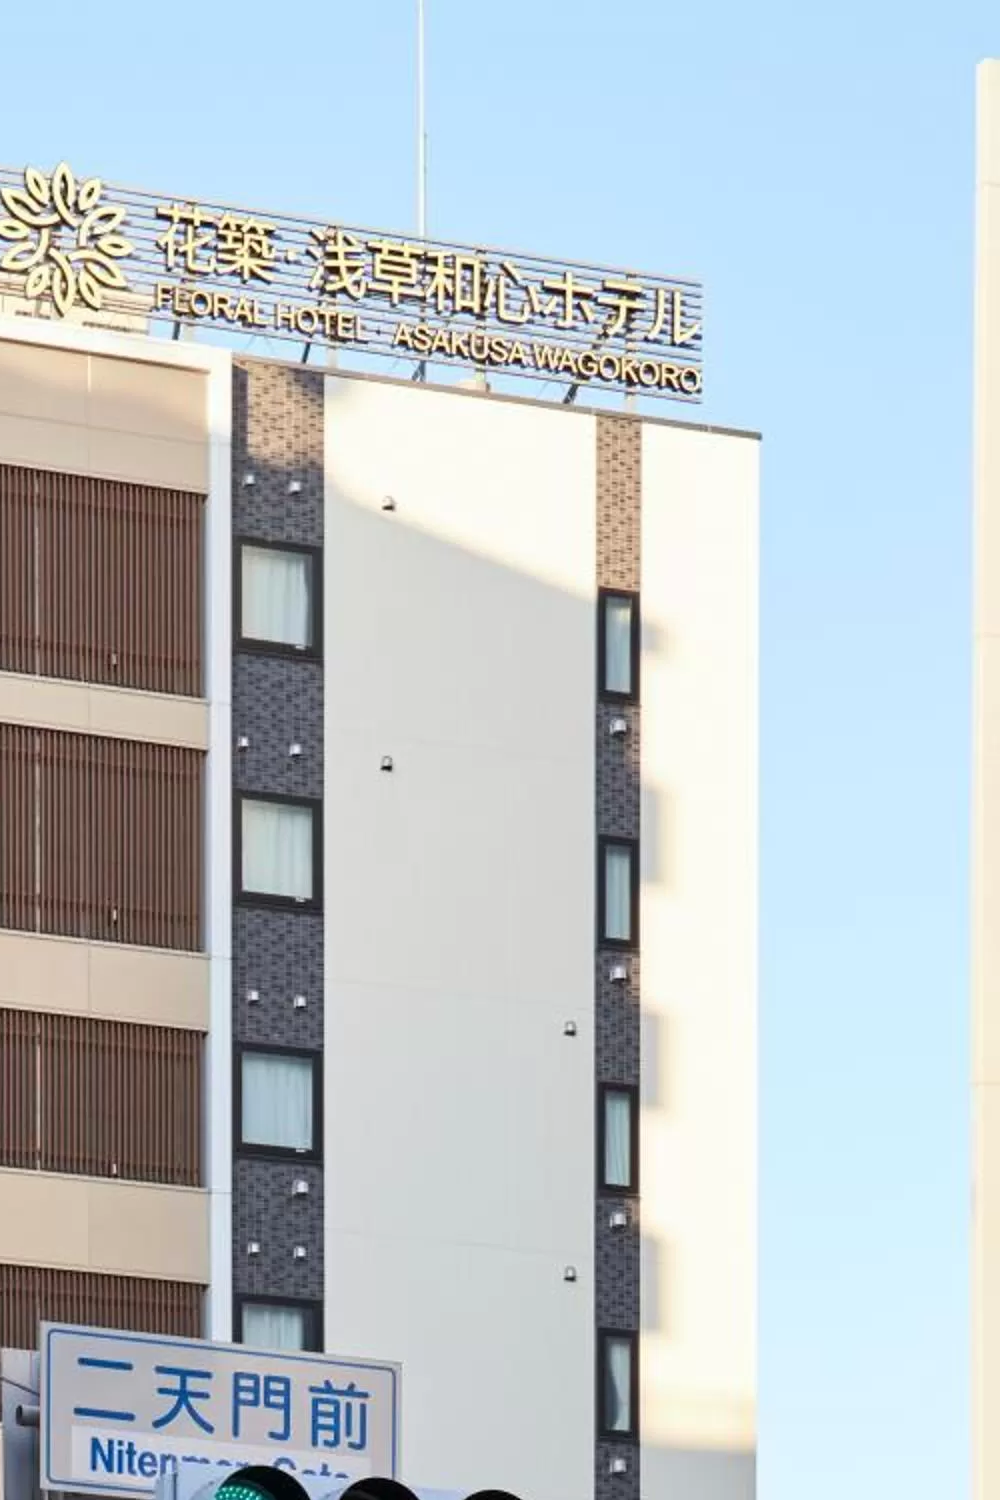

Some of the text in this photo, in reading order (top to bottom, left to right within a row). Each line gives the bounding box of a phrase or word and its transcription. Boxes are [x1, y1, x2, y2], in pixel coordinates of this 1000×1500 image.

[156, 283, 701, 394] FLORAL HOTEL ASAKUSA WAGOKORO
[73, 1356, 370, 1451] 二天門前
[90, 1436, 250, 1478] Niten
